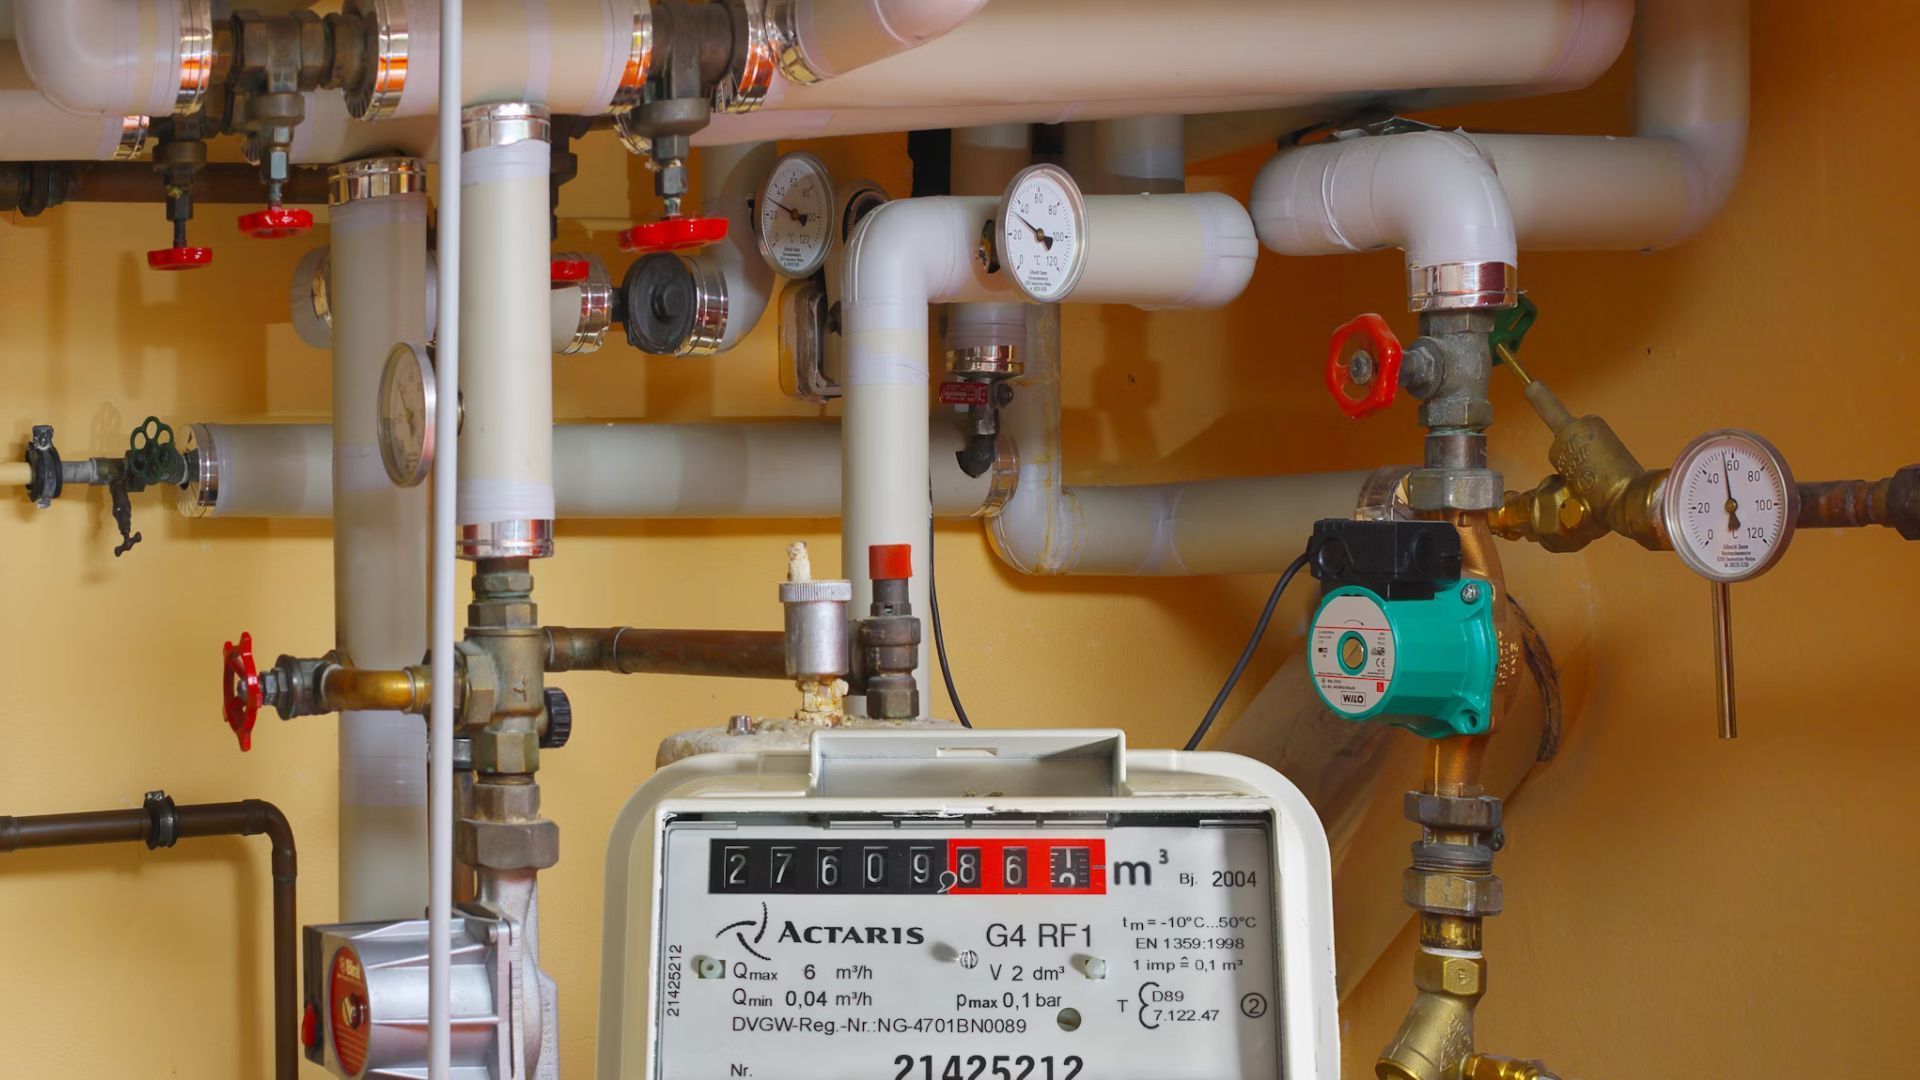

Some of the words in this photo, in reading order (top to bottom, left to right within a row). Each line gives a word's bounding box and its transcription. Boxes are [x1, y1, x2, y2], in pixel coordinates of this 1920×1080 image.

[1034, 193, 1043, 204] 60
[1020, 204, 1029, 214] 40
[1048, 205, 1057, 216] 80
[1013, 230, 1022, 240] 20
[1053, 231, 1064, 242] 100
[1046, 256, 1057, 267] 120
[1727, 460, 1740, 471] 60
[1707, 473, 1719, 484] 40
[1748, 471, 1760, 482] 80
[1698, 502, 1710, 514] 20
[1755, 499, 1772, 511] 100
[1708, 529, 1713, 540] 0
[1747, 527, 1764, 539] 120
[1342, 694, 1364, 704] WILO
[1179, 872, 1198, 888] Bj.
[1212, 870, 1257, 888] 2004
[986, 923, 1026, 948] G4
[1038, 923, 1092, 948] RF1
[1136, 937, 1157, 949] EN
[1163, 937, 1245, 949] 1359:1998
[803, 964, 816, 980] 6
[989, 963, 1002, 981] V
[1012, 965, 1023, 982] 2
[1134, 960, 1140, 971] 1
[1147, 960, 1175, 973] imp
[1195, 960, 1216, 972] 0,1
[667, 944, 683, 1017] 21425212
[785, 991, 828, 1010] 0,04
[956, 993, 998, 1011] pmax
[1002, 992, 1029, 1010] 0,1
[1036, 992, 1062, 1008] bar
[1117, 999, 1128, 1013] T
[1152, 990, 1184, 1002] D89
[1153, 1009, 1220, 1022] 7.122.47
[730, 1063, 753, 1077] Nr.
[894, 1054, 1084, 1080] 21425212
